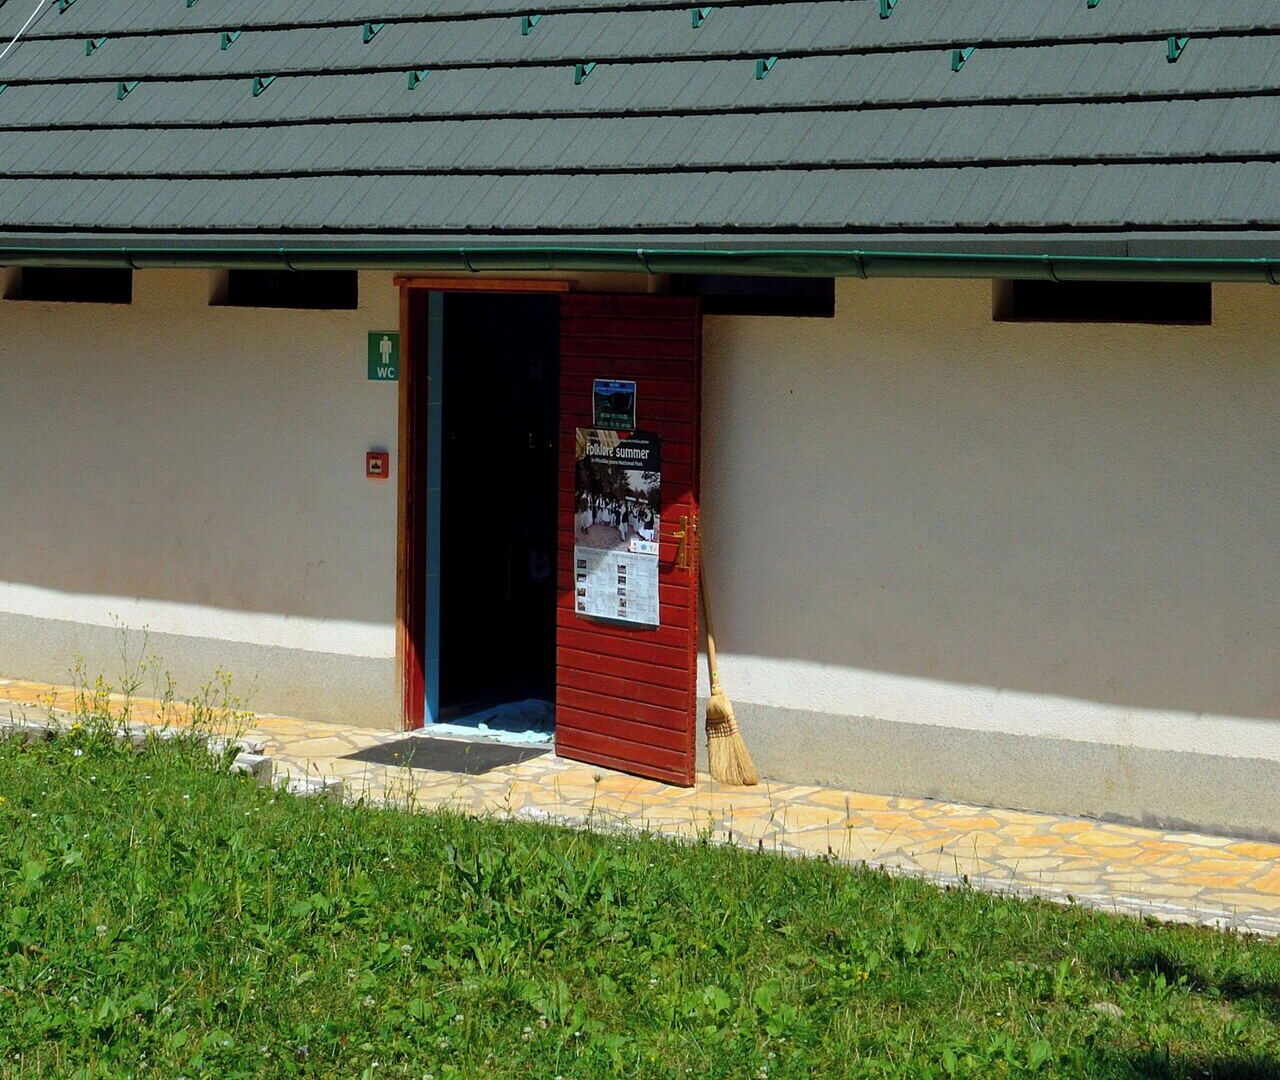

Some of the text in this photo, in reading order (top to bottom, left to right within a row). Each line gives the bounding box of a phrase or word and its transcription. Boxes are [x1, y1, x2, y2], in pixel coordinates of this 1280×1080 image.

[376, 366, 395, 378] WC
[586, 442, 650, 460] Folklore summer
